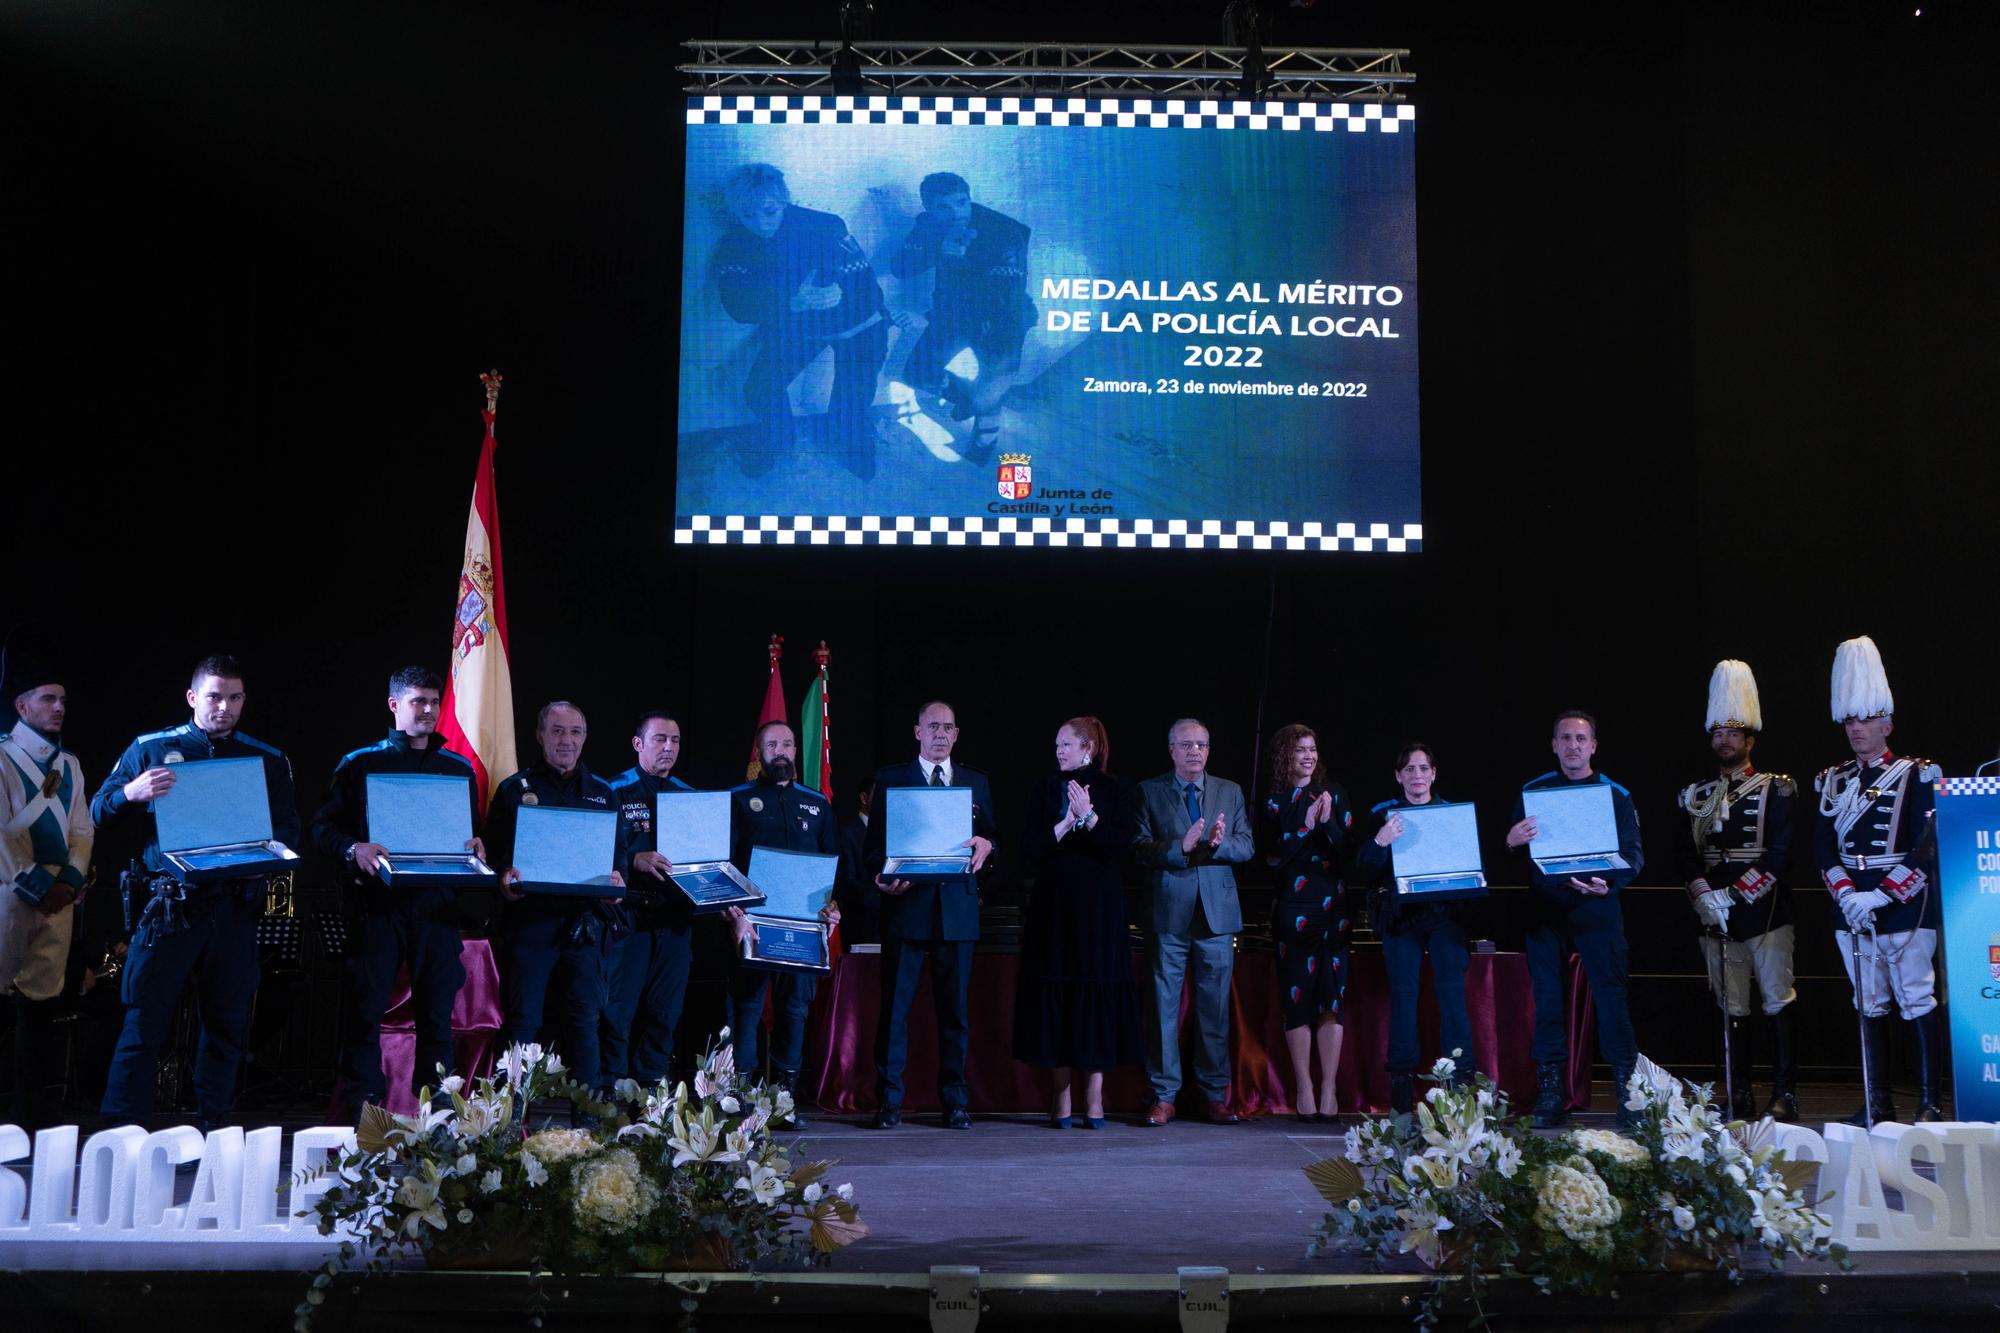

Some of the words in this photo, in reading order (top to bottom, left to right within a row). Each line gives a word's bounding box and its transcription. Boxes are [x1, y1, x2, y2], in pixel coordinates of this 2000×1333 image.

[1041, 278, 1218, 302] MEDALLAS
[1225, 282, 1270, 303] AL
[1278, 279, 1404, 306] MÉRITO
[1047, 310, 1091, 332] DE
[1101, 311, 1143, 333] LA
[1152, 310, 1282, 335] POLICÍA
[1291, 316, 1400, 338] LOCAL
[1183, 345, 1264, 368] 2022
[1083, 377, 1152, 395] Zamora,
[1156, 379, 1179, 393] 23
[1184, 380, 1204, 394] de
[1208, 380, 1294, 396] noviembre
[1297, 382, 1318, 396] de
[1322, 382, 1368, 397] 2022
[1036, 487, 1086, 500] Junta
[1091, 488, 1113, 499] de
[987, 501, 1051, 514] Castilla
[1055, 504, 1065, 517] y
[1070, 502, 1114, 515] León
[1979, 875, 2000, 894] PO
[935, 1300, 977, 1311] GUIL
